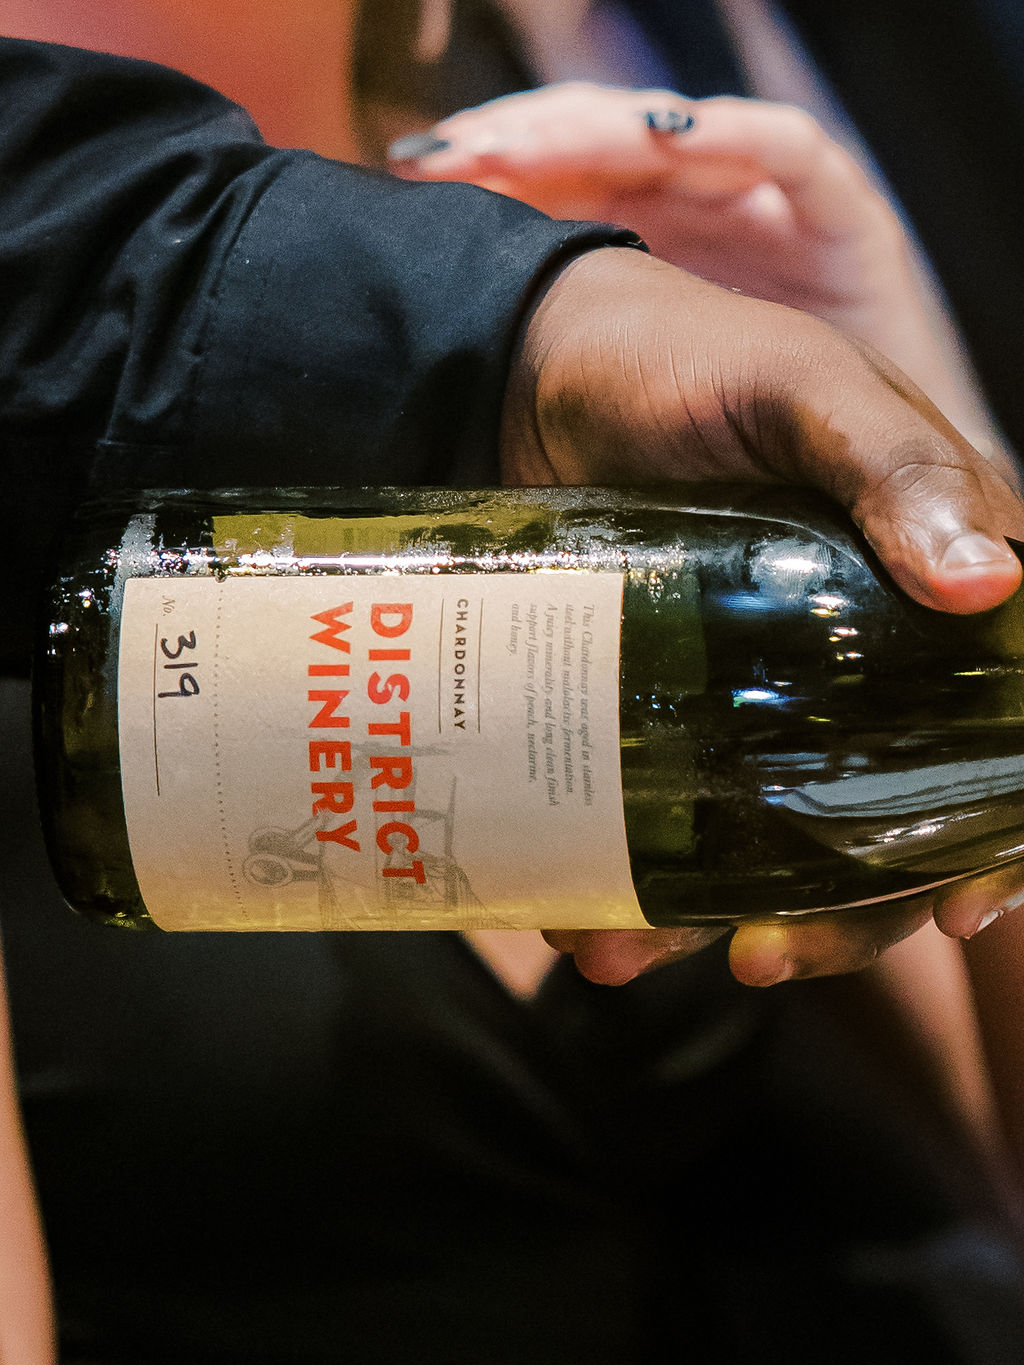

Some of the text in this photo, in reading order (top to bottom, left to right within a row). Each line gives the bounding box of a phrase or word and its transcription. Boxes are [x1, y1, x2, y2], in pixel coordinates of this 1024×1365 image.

[506, 604, 522, 656] and honey.
[543, 611, 558, 638] juicy
[158, 630, 200, 698] 319
[454, 599, 469, 730] CHARDONNAY
[525, 640, 539, 679] flavors
[564, 627, 575, 666] without
[541, 642, 555, 695] minerality
[524, 683, 538, 697] of
[545, 699, 556, 719] and
[562, 671, 575, 724] malolactic
[577, 605, 595, 806] This Chardonnay was aged in stainless
[307, 601, 362, 853] WINERY
[524, 696, 538, 728] peach,
[367, 602, 426, 885] DISTRICT
[542, 723, 556, 744] long
[546, 747, 557, 774] clean
[544, 775, 560, 806] finish
